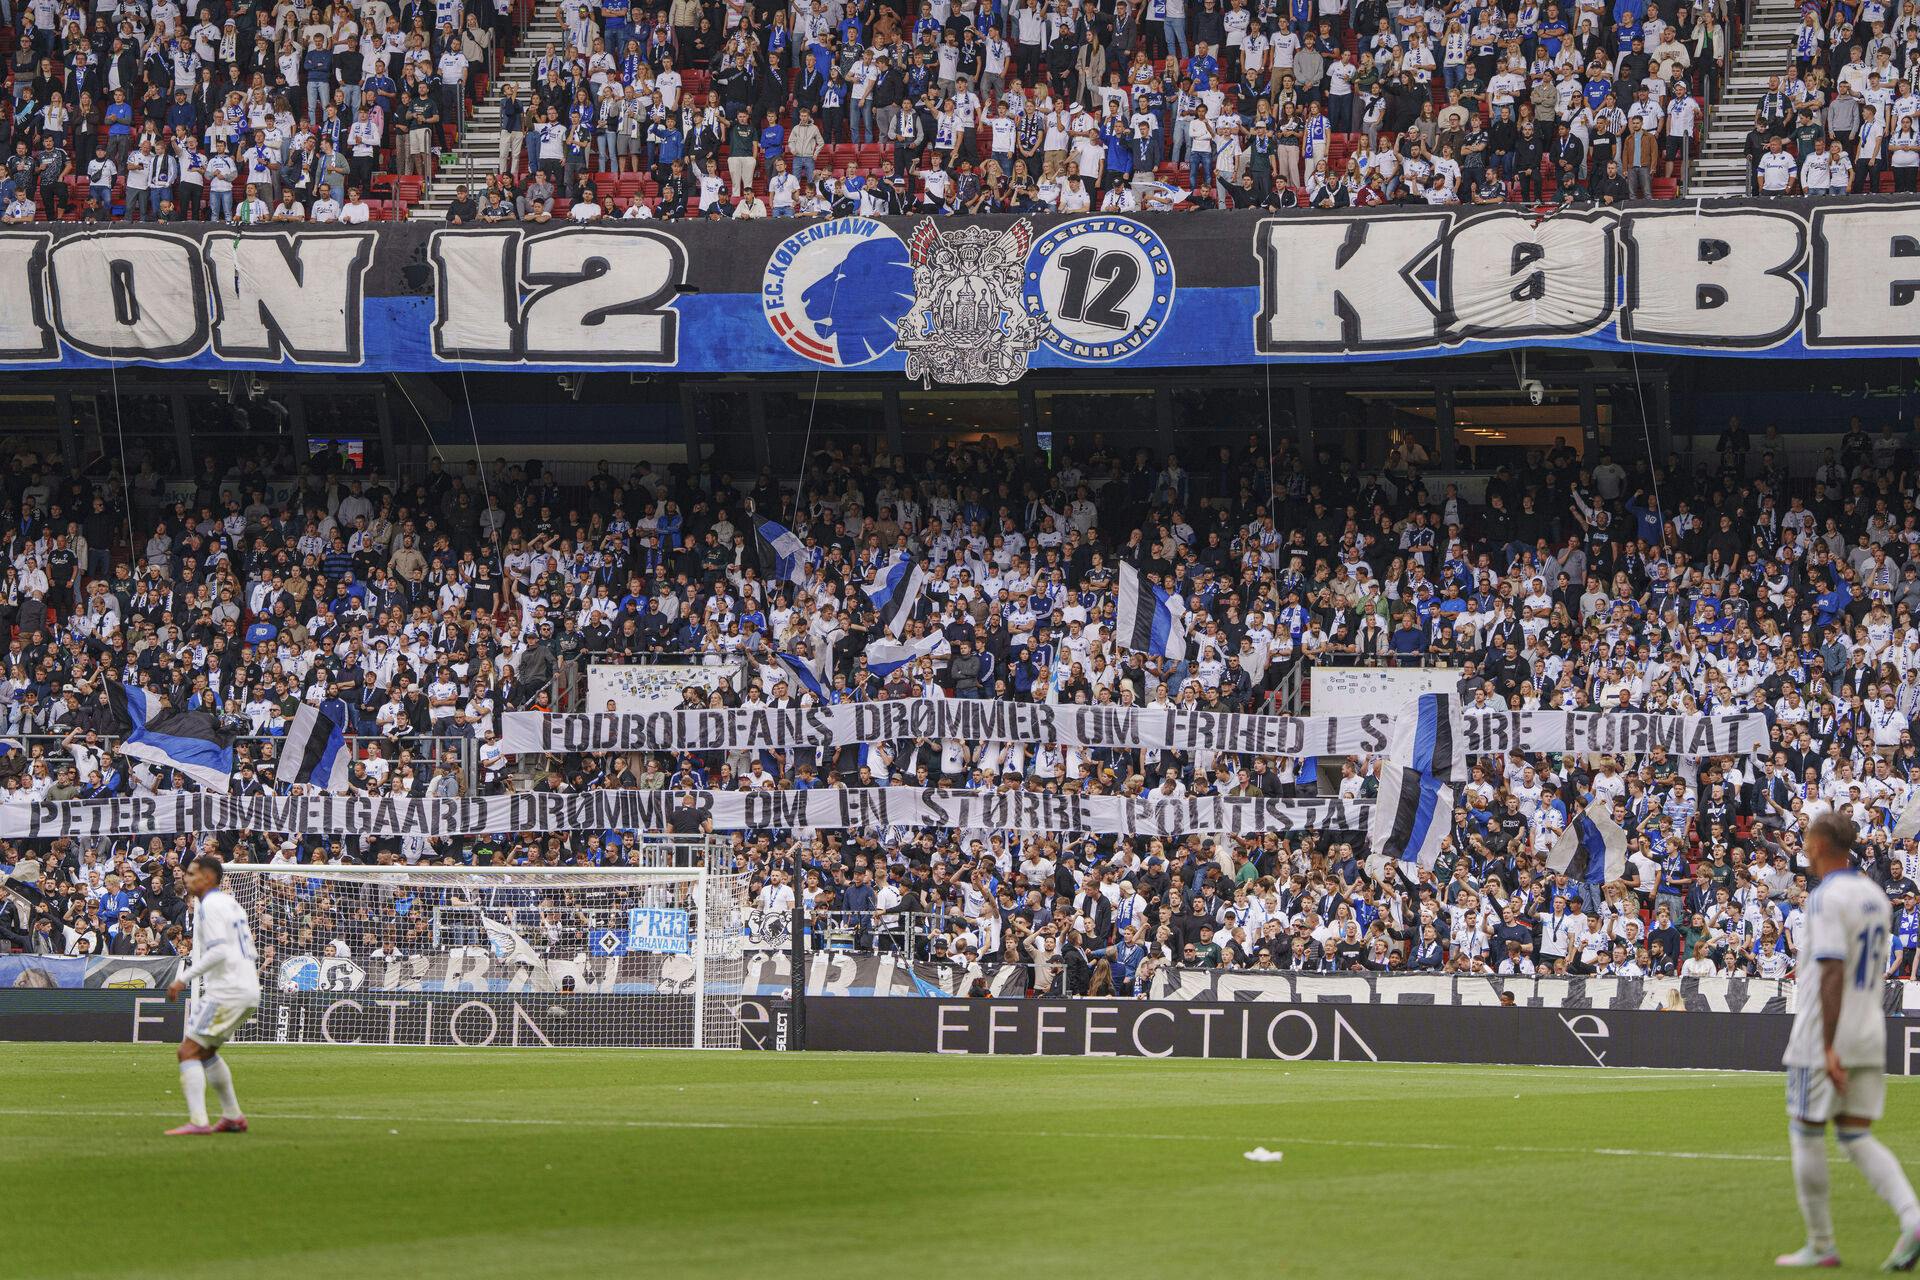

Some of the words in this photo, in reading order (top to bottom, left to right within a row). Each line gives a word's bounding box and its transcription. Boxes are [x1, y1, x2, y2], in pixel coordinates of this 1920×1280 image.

[1039, 221, 1151, 256] SEKTION
[1150, 246, 1168, 276] 12
[430, 227, 688, 366] 12
[1058, 245, 1141, 331] 12
[1027, 295, 1158, 358] KBENHAVN
[542, 703, 834, 751] FODBOLDFANS
[855, 699, 1055, 743] DRØMMER
[1076, 704, 1139, 745] OM
[1166, 710, 1304, 755] FRIHED
[1326, 716, 1337, 753] I
[1360, 712, 1532, 753] SRRE
[1565, 711, 1749, 756] FORMAT
[29, 796, 157, 837] PETER
[176, 794, 488, 836] HUMMELGAARD
[510, 790, 714, 831] DRØMMER
[745, 790, 807, 829] OM
[841, 789, 888, 826] EN
[921, 788, 1091, 831] STØRRE
[133, 997, 554, 1047] ECTION
[776, 1012, 788, 1052] SELECT
[936, 1004, 1378, 1062] EFFECTION
